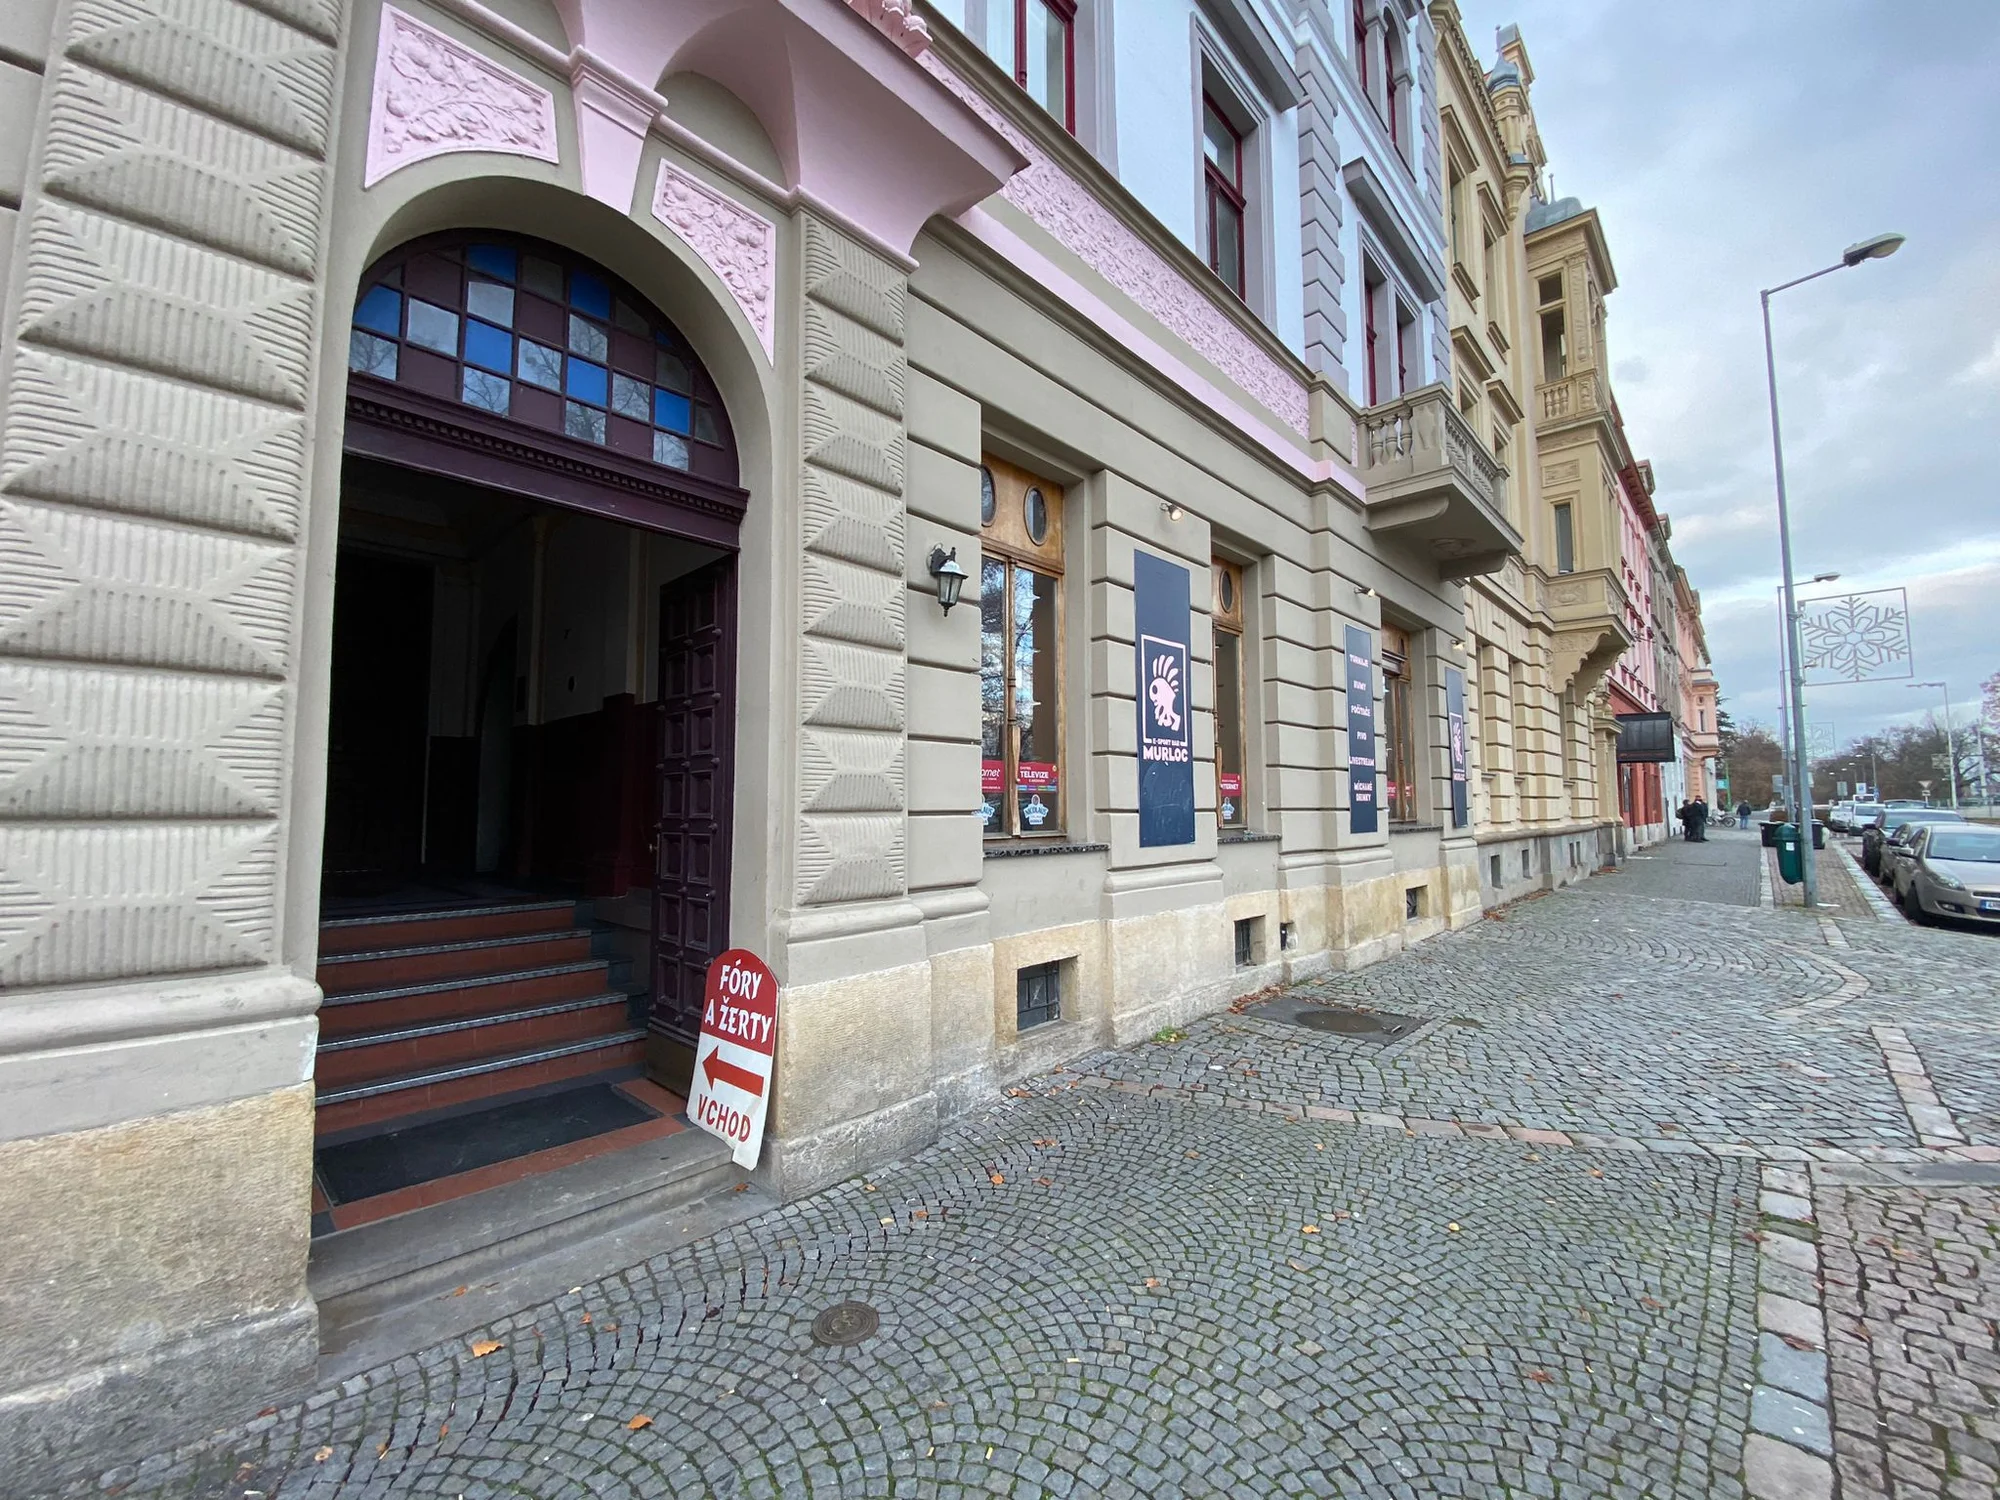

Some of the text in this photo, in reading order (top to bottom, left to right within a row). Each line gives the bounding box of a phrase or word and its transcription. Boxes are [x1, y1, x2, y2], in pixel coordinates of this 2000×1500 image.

[1143, 745, 1189, 762] MURLOC
[719, 959, 762, 1000] FÓRY
[704, 995, 773, 1044] A ŽERTY
[697, 1093, 751, 1143] VCHOD
